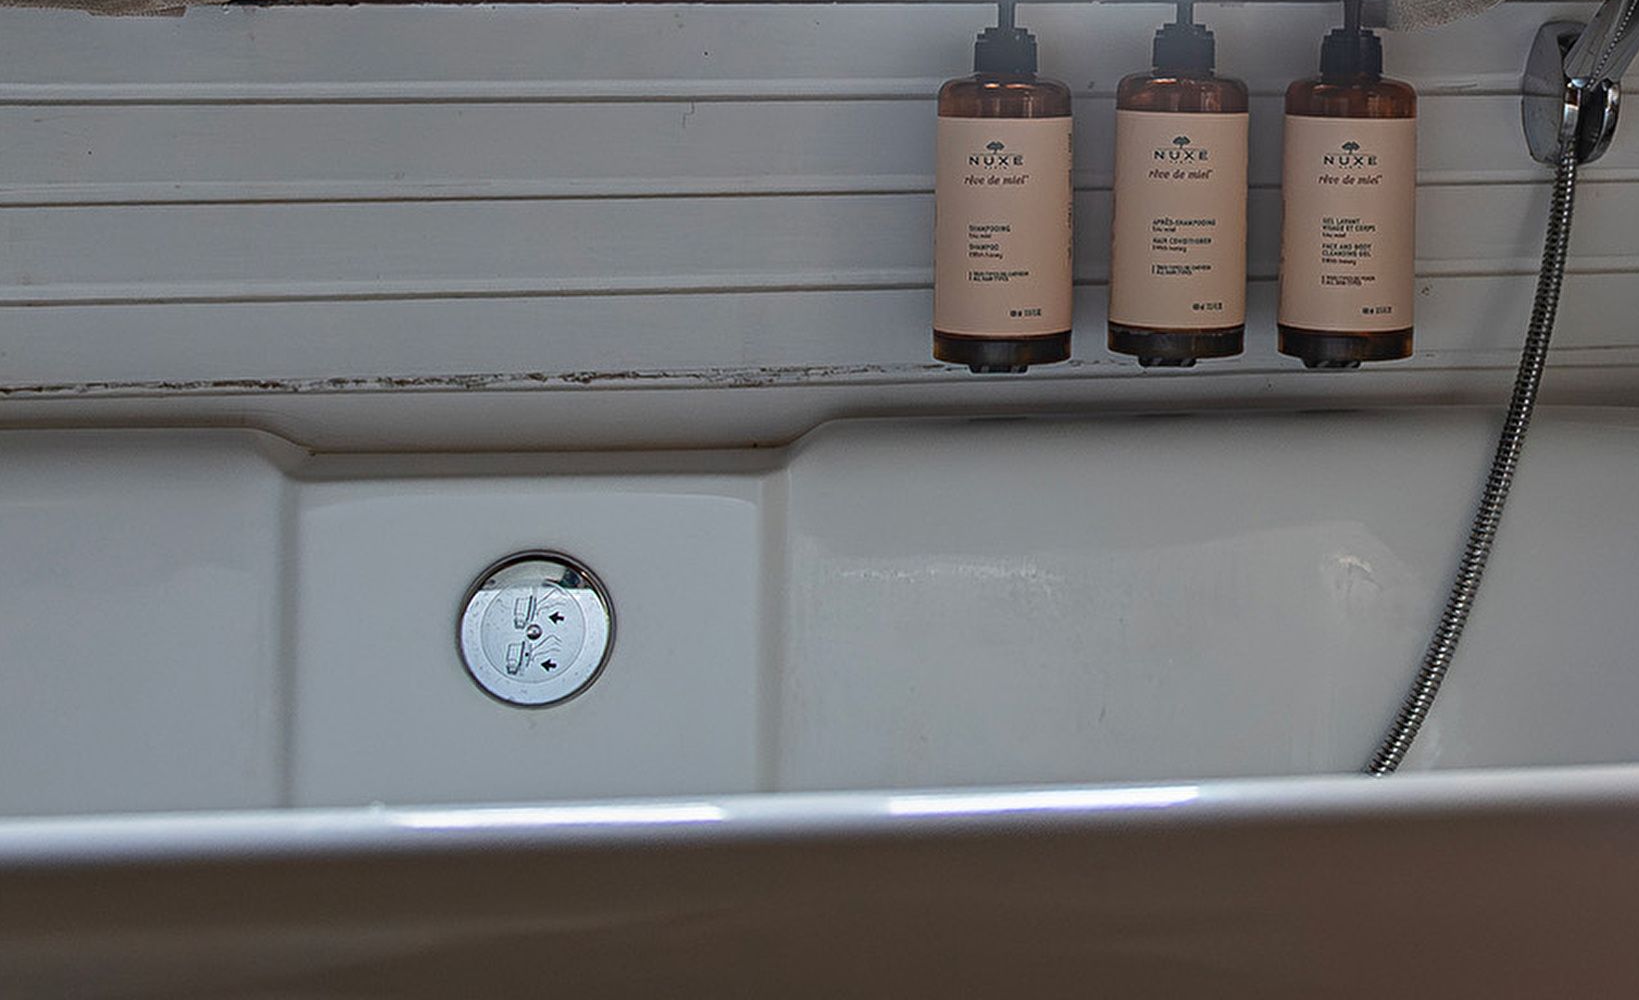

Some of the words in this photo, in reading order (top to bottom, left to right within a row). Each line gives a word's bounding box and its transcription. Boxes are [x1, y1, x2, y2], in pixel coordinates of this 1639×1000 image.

[968, 155, 1023, 166] NUXE
[1153, 150, 1208, 161] NUXE
[1323, 155, 1377, 166] NUXE
[963, 174, 985, 185] rêve
[987, 174, 1001, 185] de
[1148, 168, 1170, 179] rêve
[1172, 169, 1186, 180] de
[1318, 174, 1340, 185] rêve
[1341, 174, 1355, 185] de
[968, 243, 1000, 251] SHAMPOO
